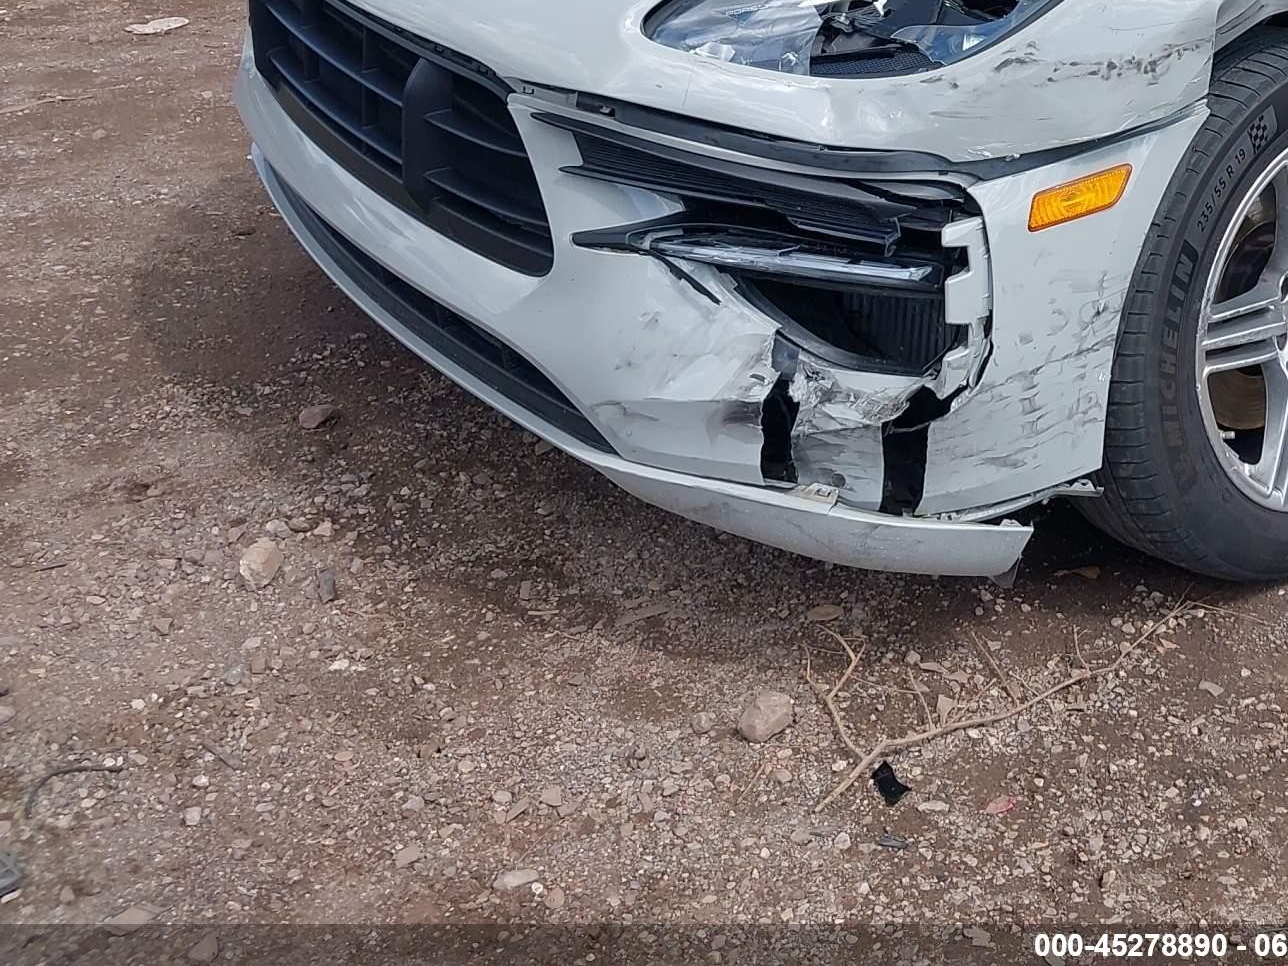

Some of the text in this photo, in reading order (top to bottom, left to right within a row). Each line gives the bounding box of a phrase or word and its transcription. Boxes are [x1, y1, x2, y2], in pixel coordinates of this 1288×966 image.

[1196, 147, 1247, 233] 235/55 R 19
[1158, 254, 1196, 448] MICHELIN
